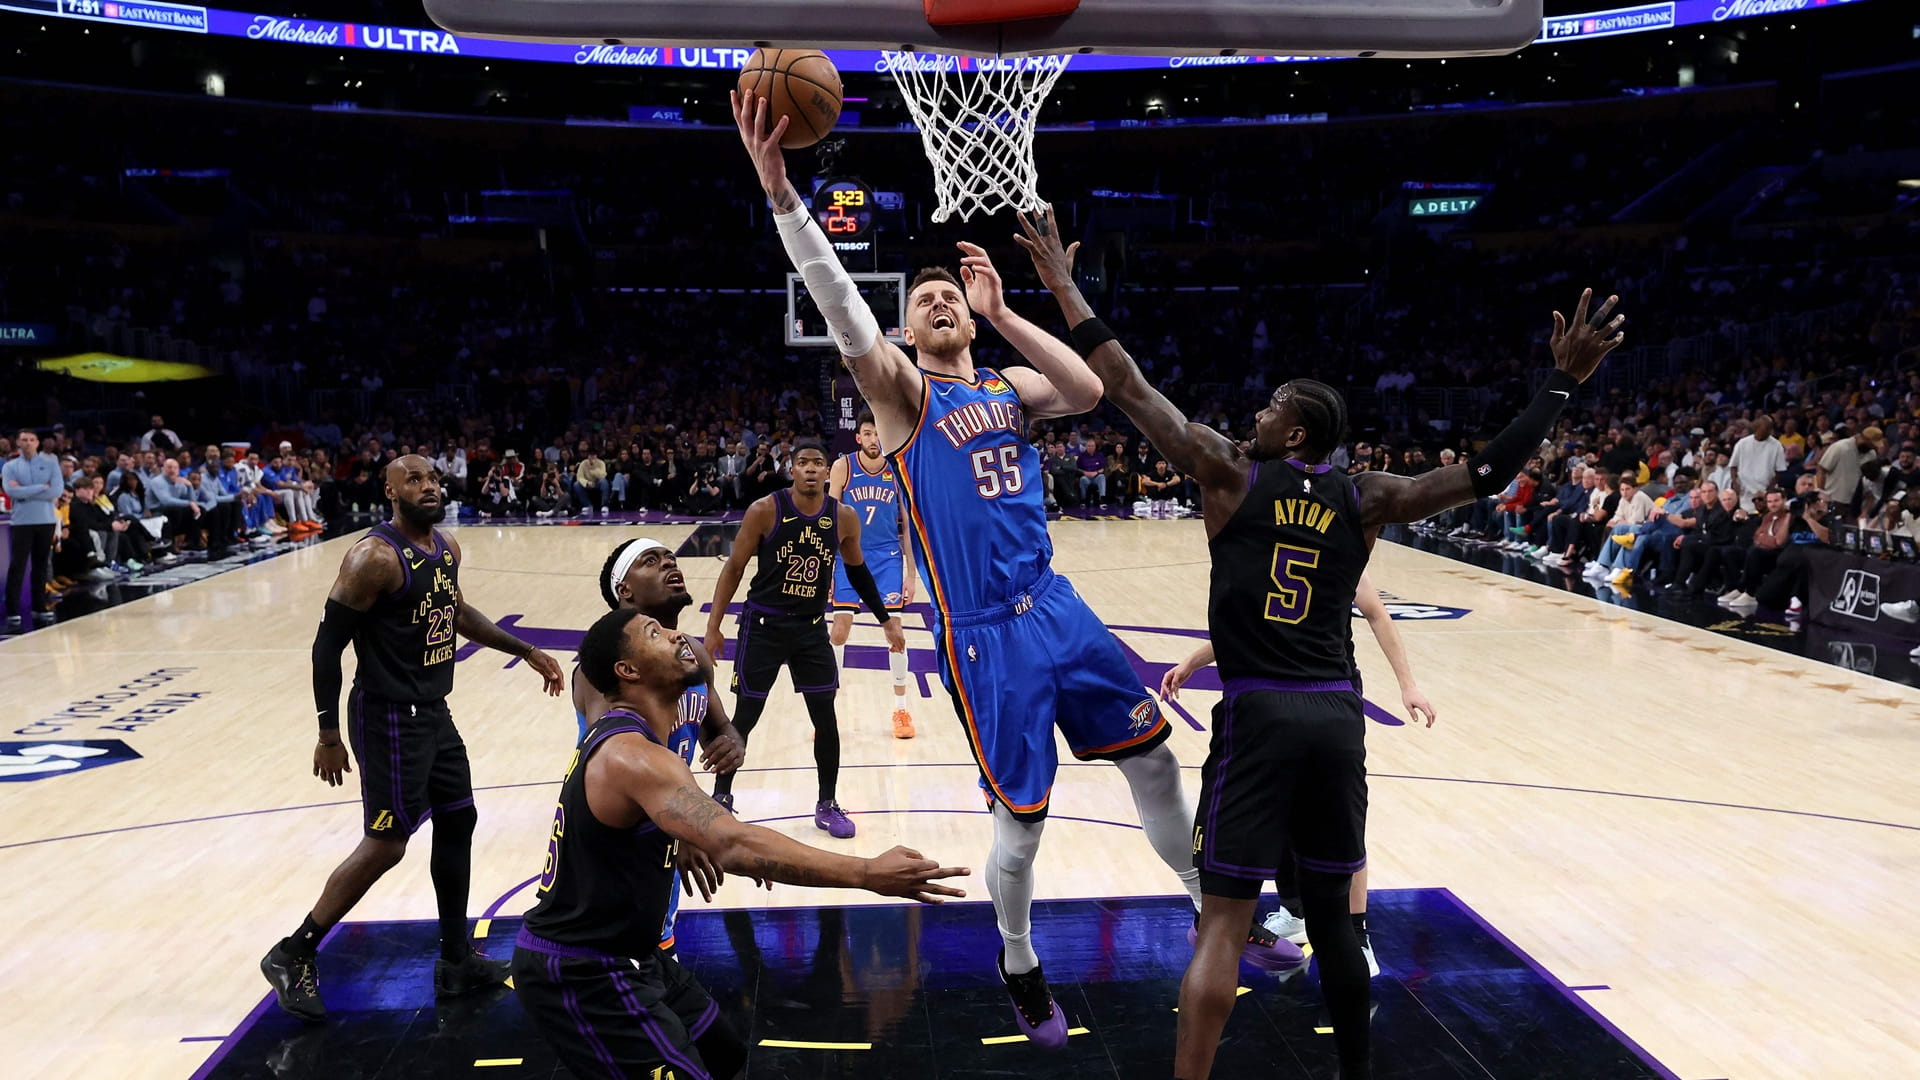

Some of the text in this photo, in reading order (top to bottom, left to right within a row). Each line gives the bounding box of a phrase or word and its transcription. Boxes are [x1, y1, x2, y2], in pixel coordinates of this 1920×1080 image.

[247, 16, 459, 53] Michelob ULTRA
[1552, 21, 1579, 35] 7:51
[574, 44, 749, 68] Michelob ULTR
[833, 190, 864, 206] 9:23
[834, 243, 870, 251] TISSOT
[841, 397, 853, 408] GET
[841, 408, 853, 418] THE
[935, 401, 1025, 449] THUNDER
[970, 444, 1024, 499] 55
[850, 486, 895, 504] THUNDER
[865, 506, 876, 525] 7
[1274, 499, 1336, 534] AYTON
[776, 526, 832, 566] LOS ANGELES
[786, 555, 820, 582] 28
[782, 582, 816, 597] LAKERS
[1264, 542, 1320, 625] 5
[412, 592, 432, 624] LOS
[426, 605, 454, 646] 23
[423, 644, 453, 667] LAKERS
[96, 691, 212, 732] ARENA
[369, 810, 393, 831] LA
